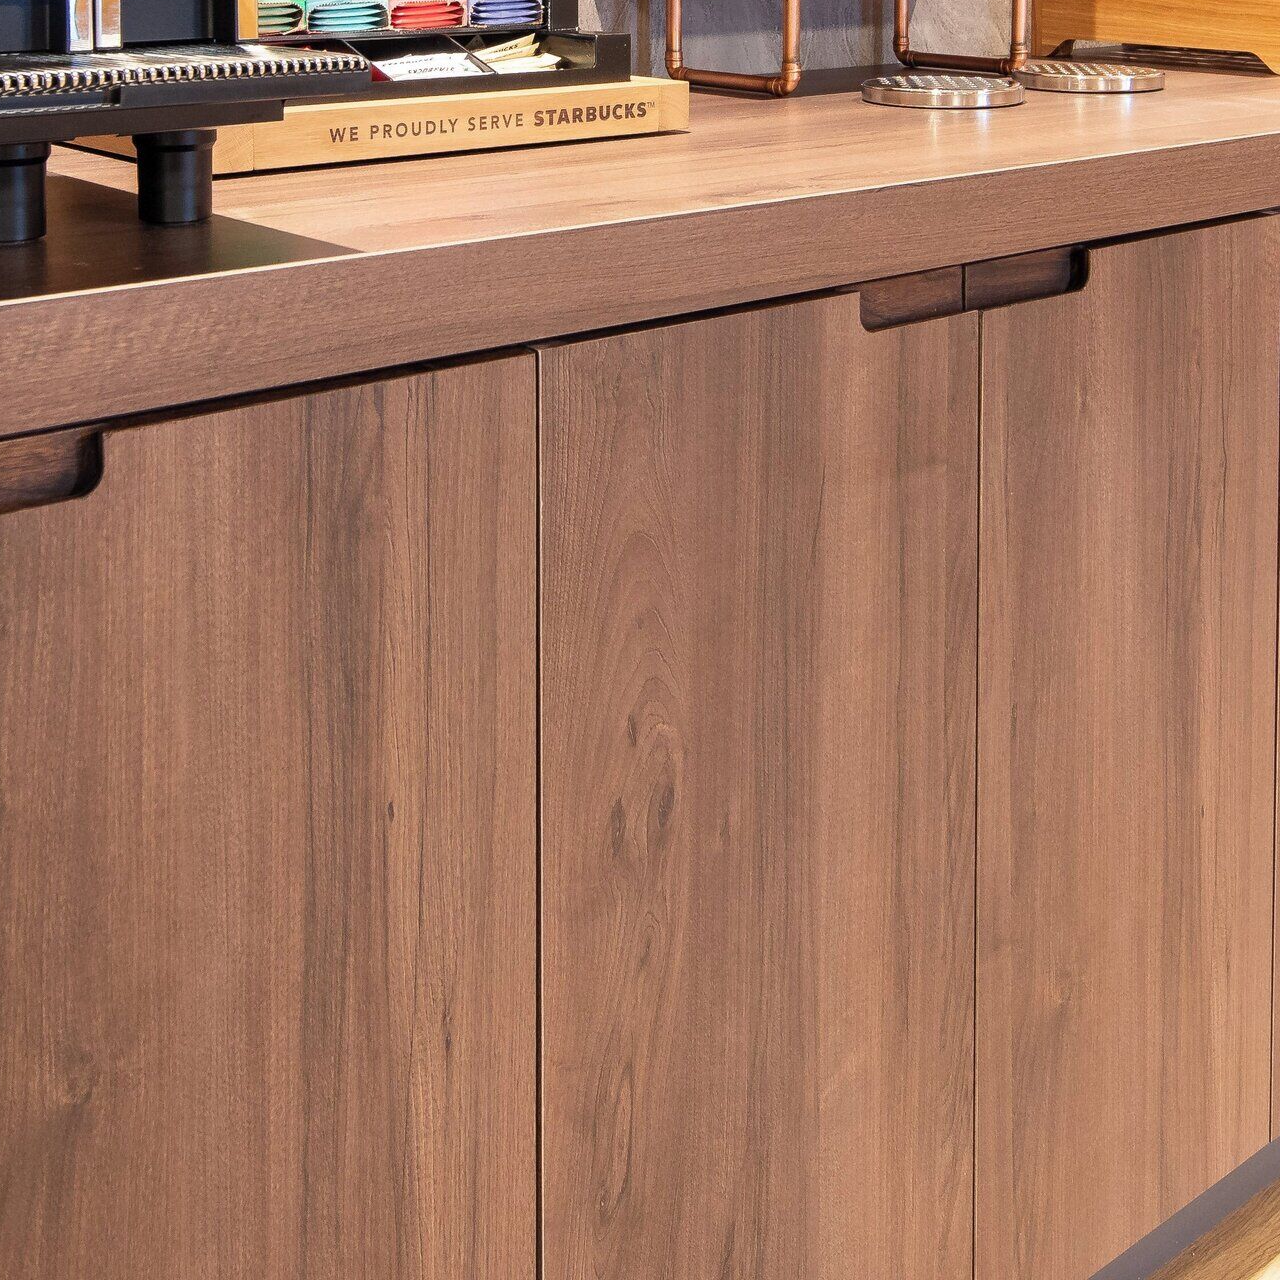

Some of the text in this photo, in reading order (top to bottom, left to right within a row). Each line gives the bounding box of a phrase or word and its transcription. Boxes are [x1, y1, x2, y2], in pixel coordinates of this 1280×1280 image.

[329, 126, 359, 144] WE
[370, 118, 458, 140] PROUDLY
[467, 113, 524, 131] SERVE
